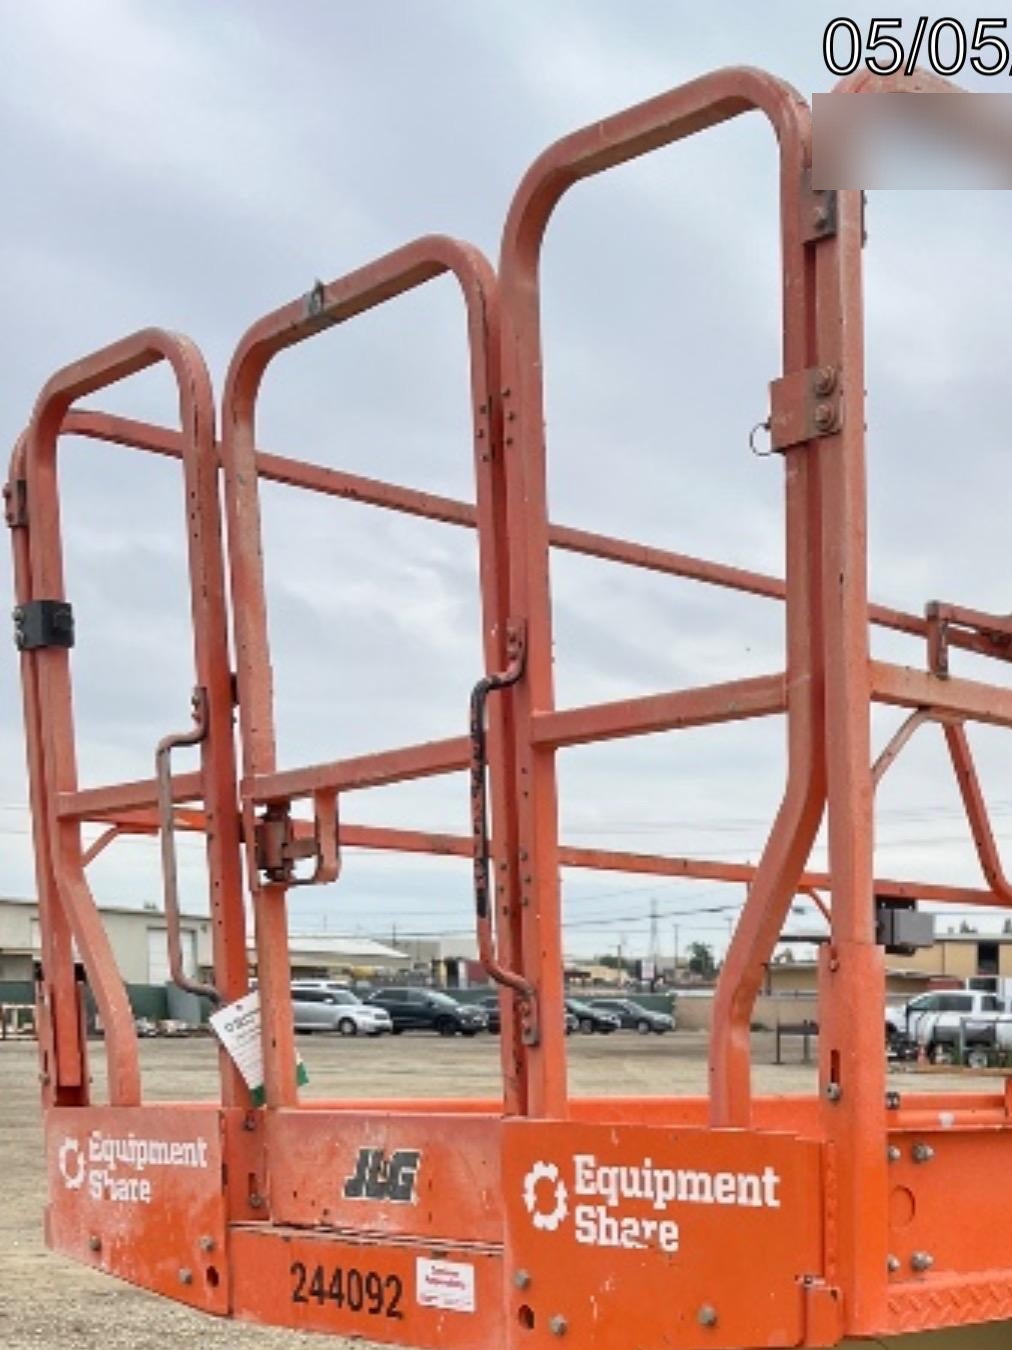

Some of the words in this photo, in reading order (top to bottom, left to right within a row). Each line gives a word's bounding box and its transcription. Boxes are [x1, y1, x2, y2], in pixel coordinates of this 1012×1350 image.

[89, 1130, 208, 1171] Equipment
[342, 1146, 423, 1205] JLG
[89, 1169, 151, 1203] Share
[573, 1154, 781, 1209] Equipment
[574, 1205, 679, 1252] Share
[290, 1262, 404, 1320] 244092
